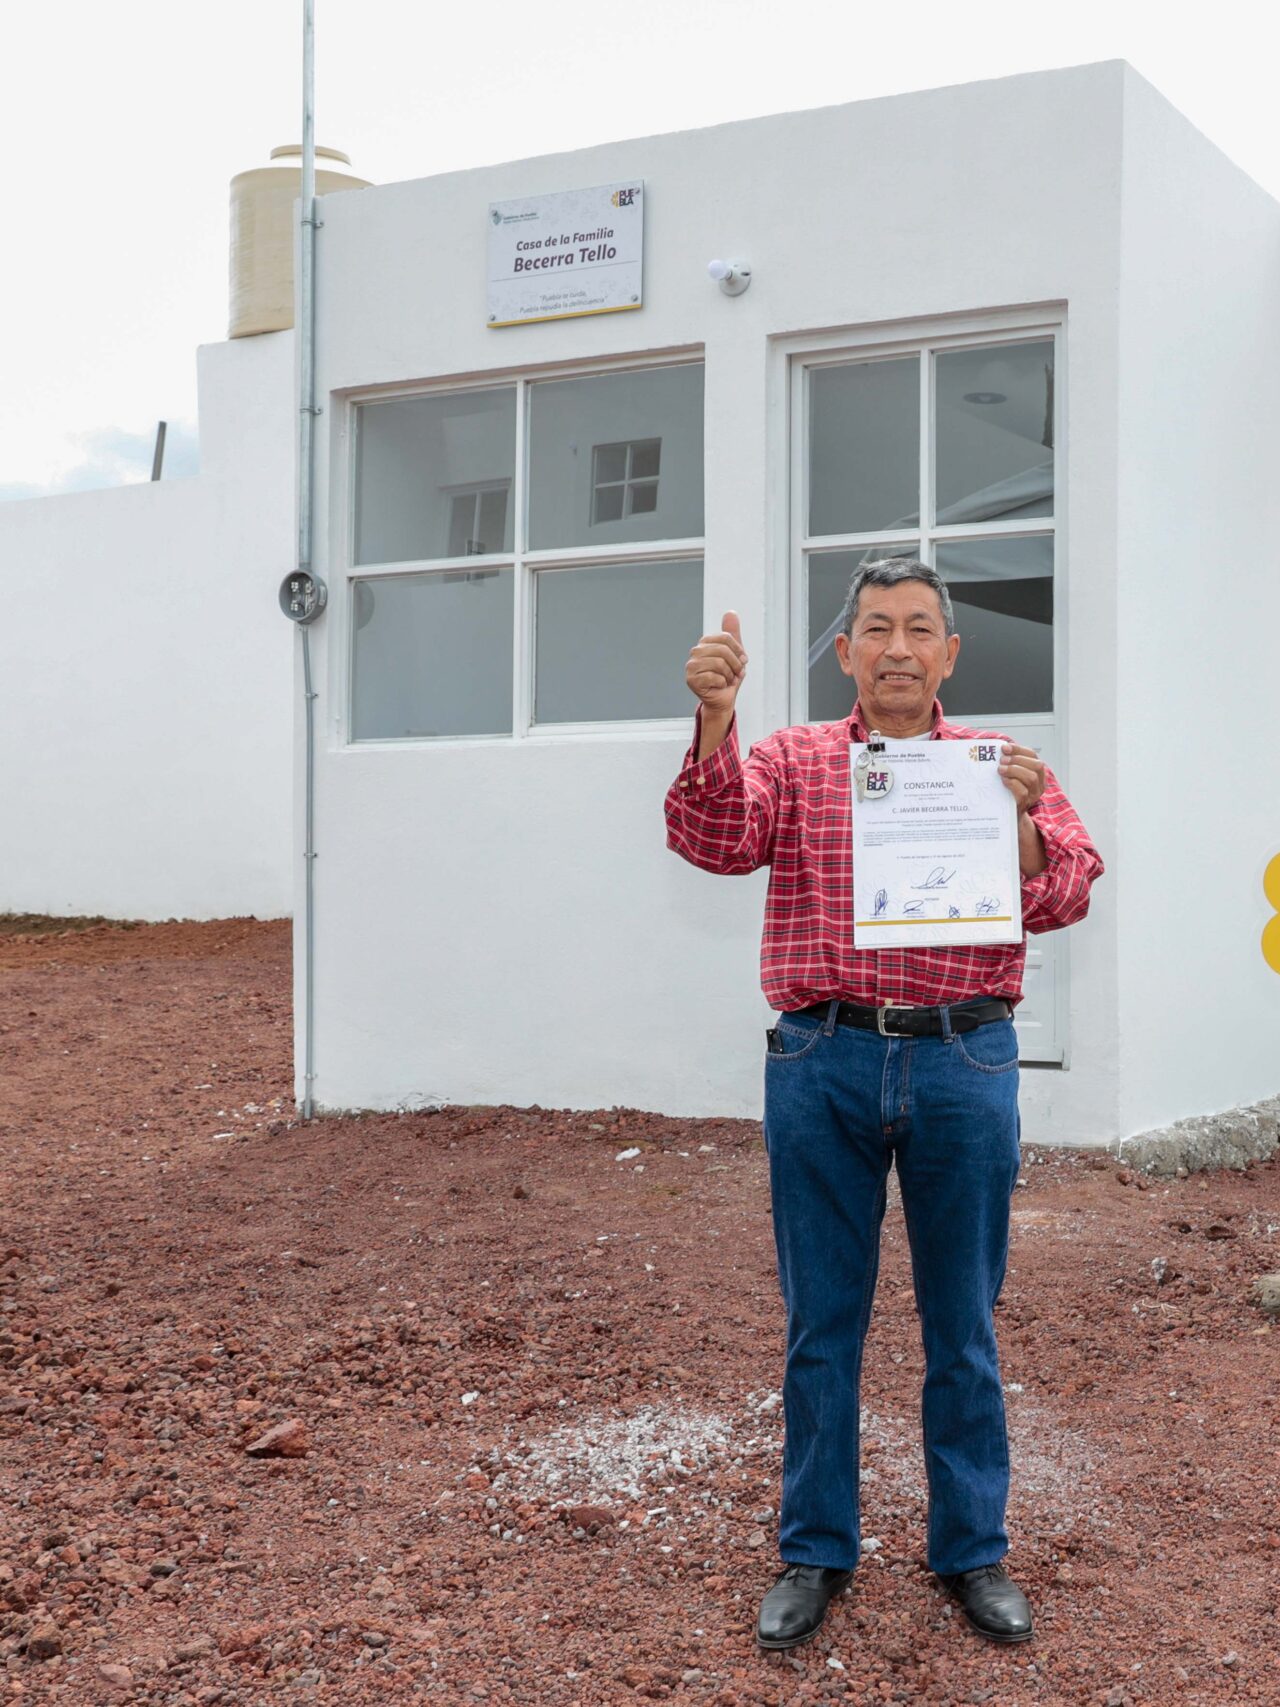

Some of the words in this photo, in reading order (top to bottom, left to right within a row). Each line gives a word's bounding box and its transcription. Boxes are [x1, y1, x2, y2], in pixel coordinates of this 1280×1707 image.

[516, 240, 542, 251] Casa
[544, 236, 558, 247] de
[560, 234, 570, 245] la
[573, 227, 614, 243] Familia
[513, 253, 574, 272] Becerra
[579, 243, 617, 263] Tello
[978, 746, 996, 754] PUE
[978, 753, 996, 761] BLA
[868, 772, 889, 782] PUE
[866, 780, 887, 791] BLA
[903, 781, 955, 790] CONSTANCIA
